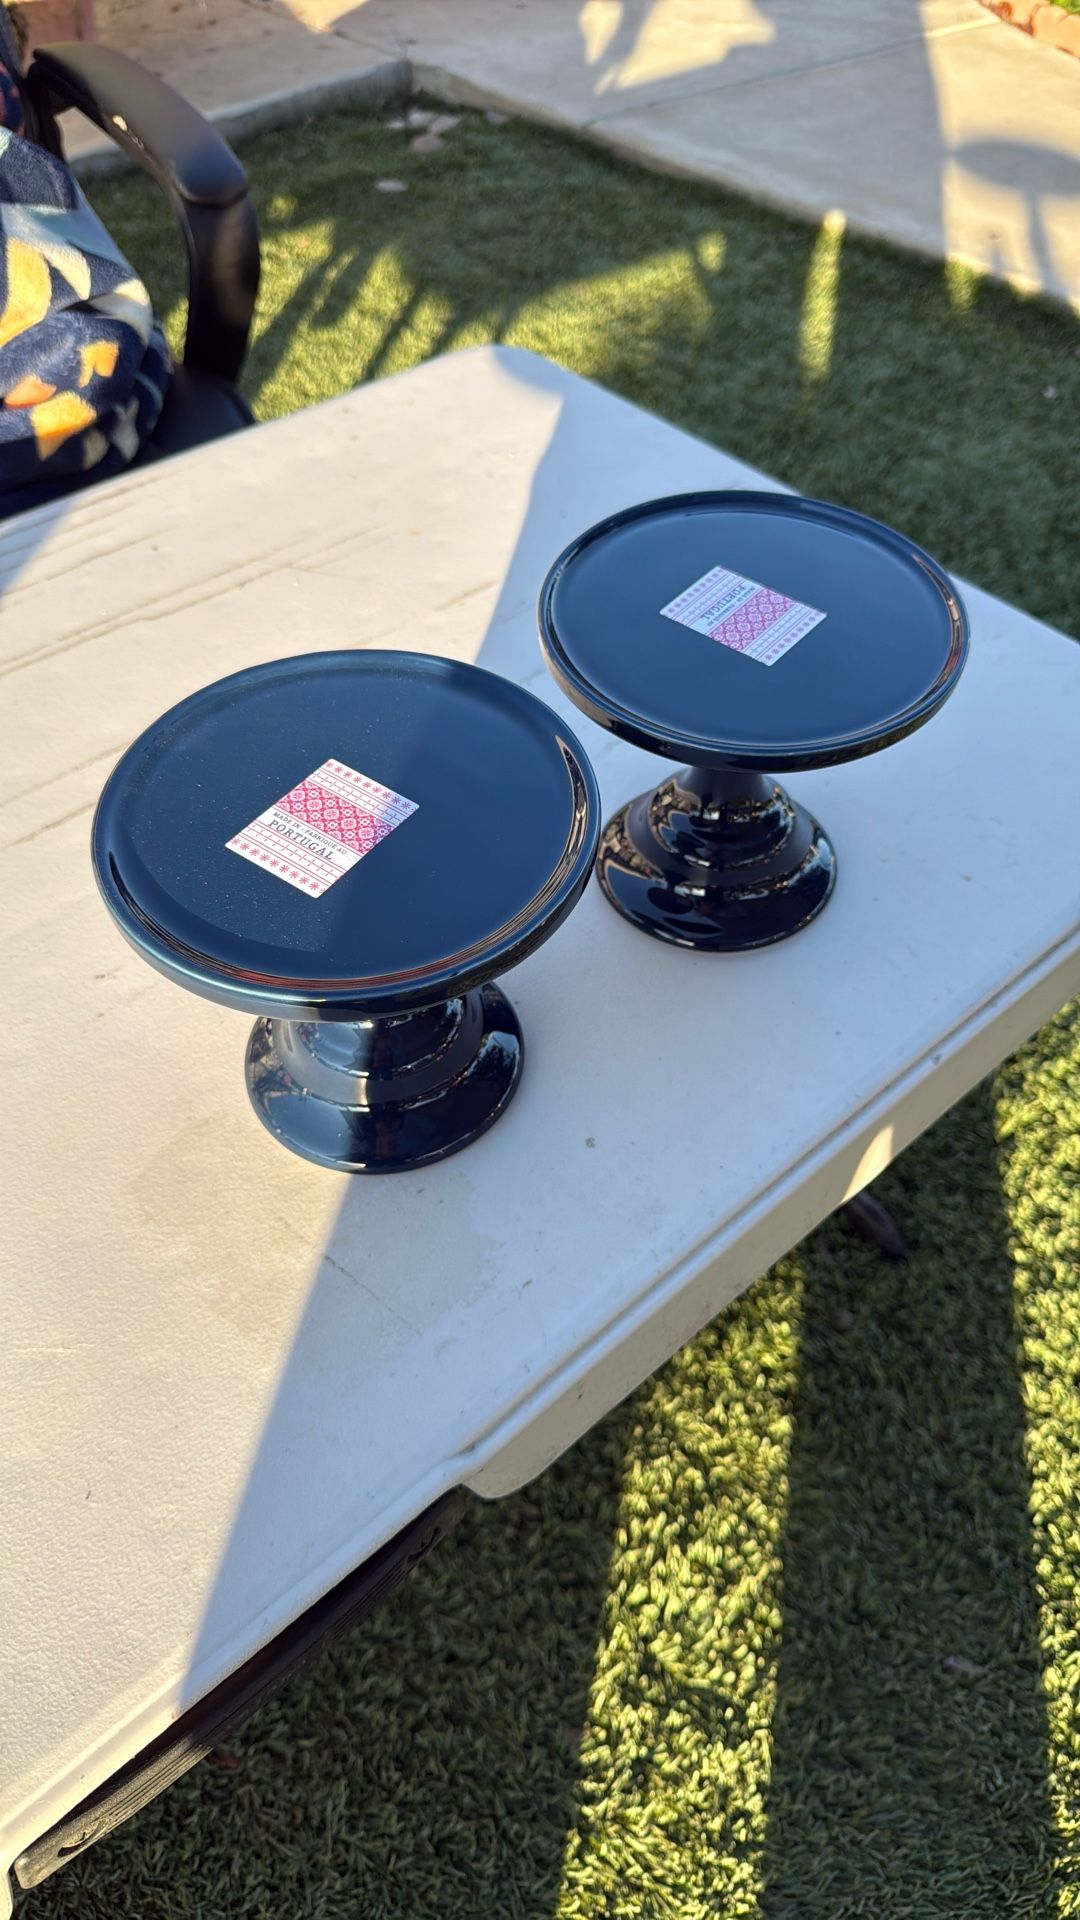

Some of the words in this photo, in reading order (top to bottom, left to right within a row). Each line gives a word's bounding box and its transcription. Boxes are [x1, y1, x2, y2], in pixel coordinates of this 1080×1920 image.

[700, 585, 746, 620] PORTUGAL
[268, 819, 334, 860] PORTUGAL
[273, 812, 292, 824] MADE
[292, 821, 301, 829] IN
[337, 847, 347, 855] AU
